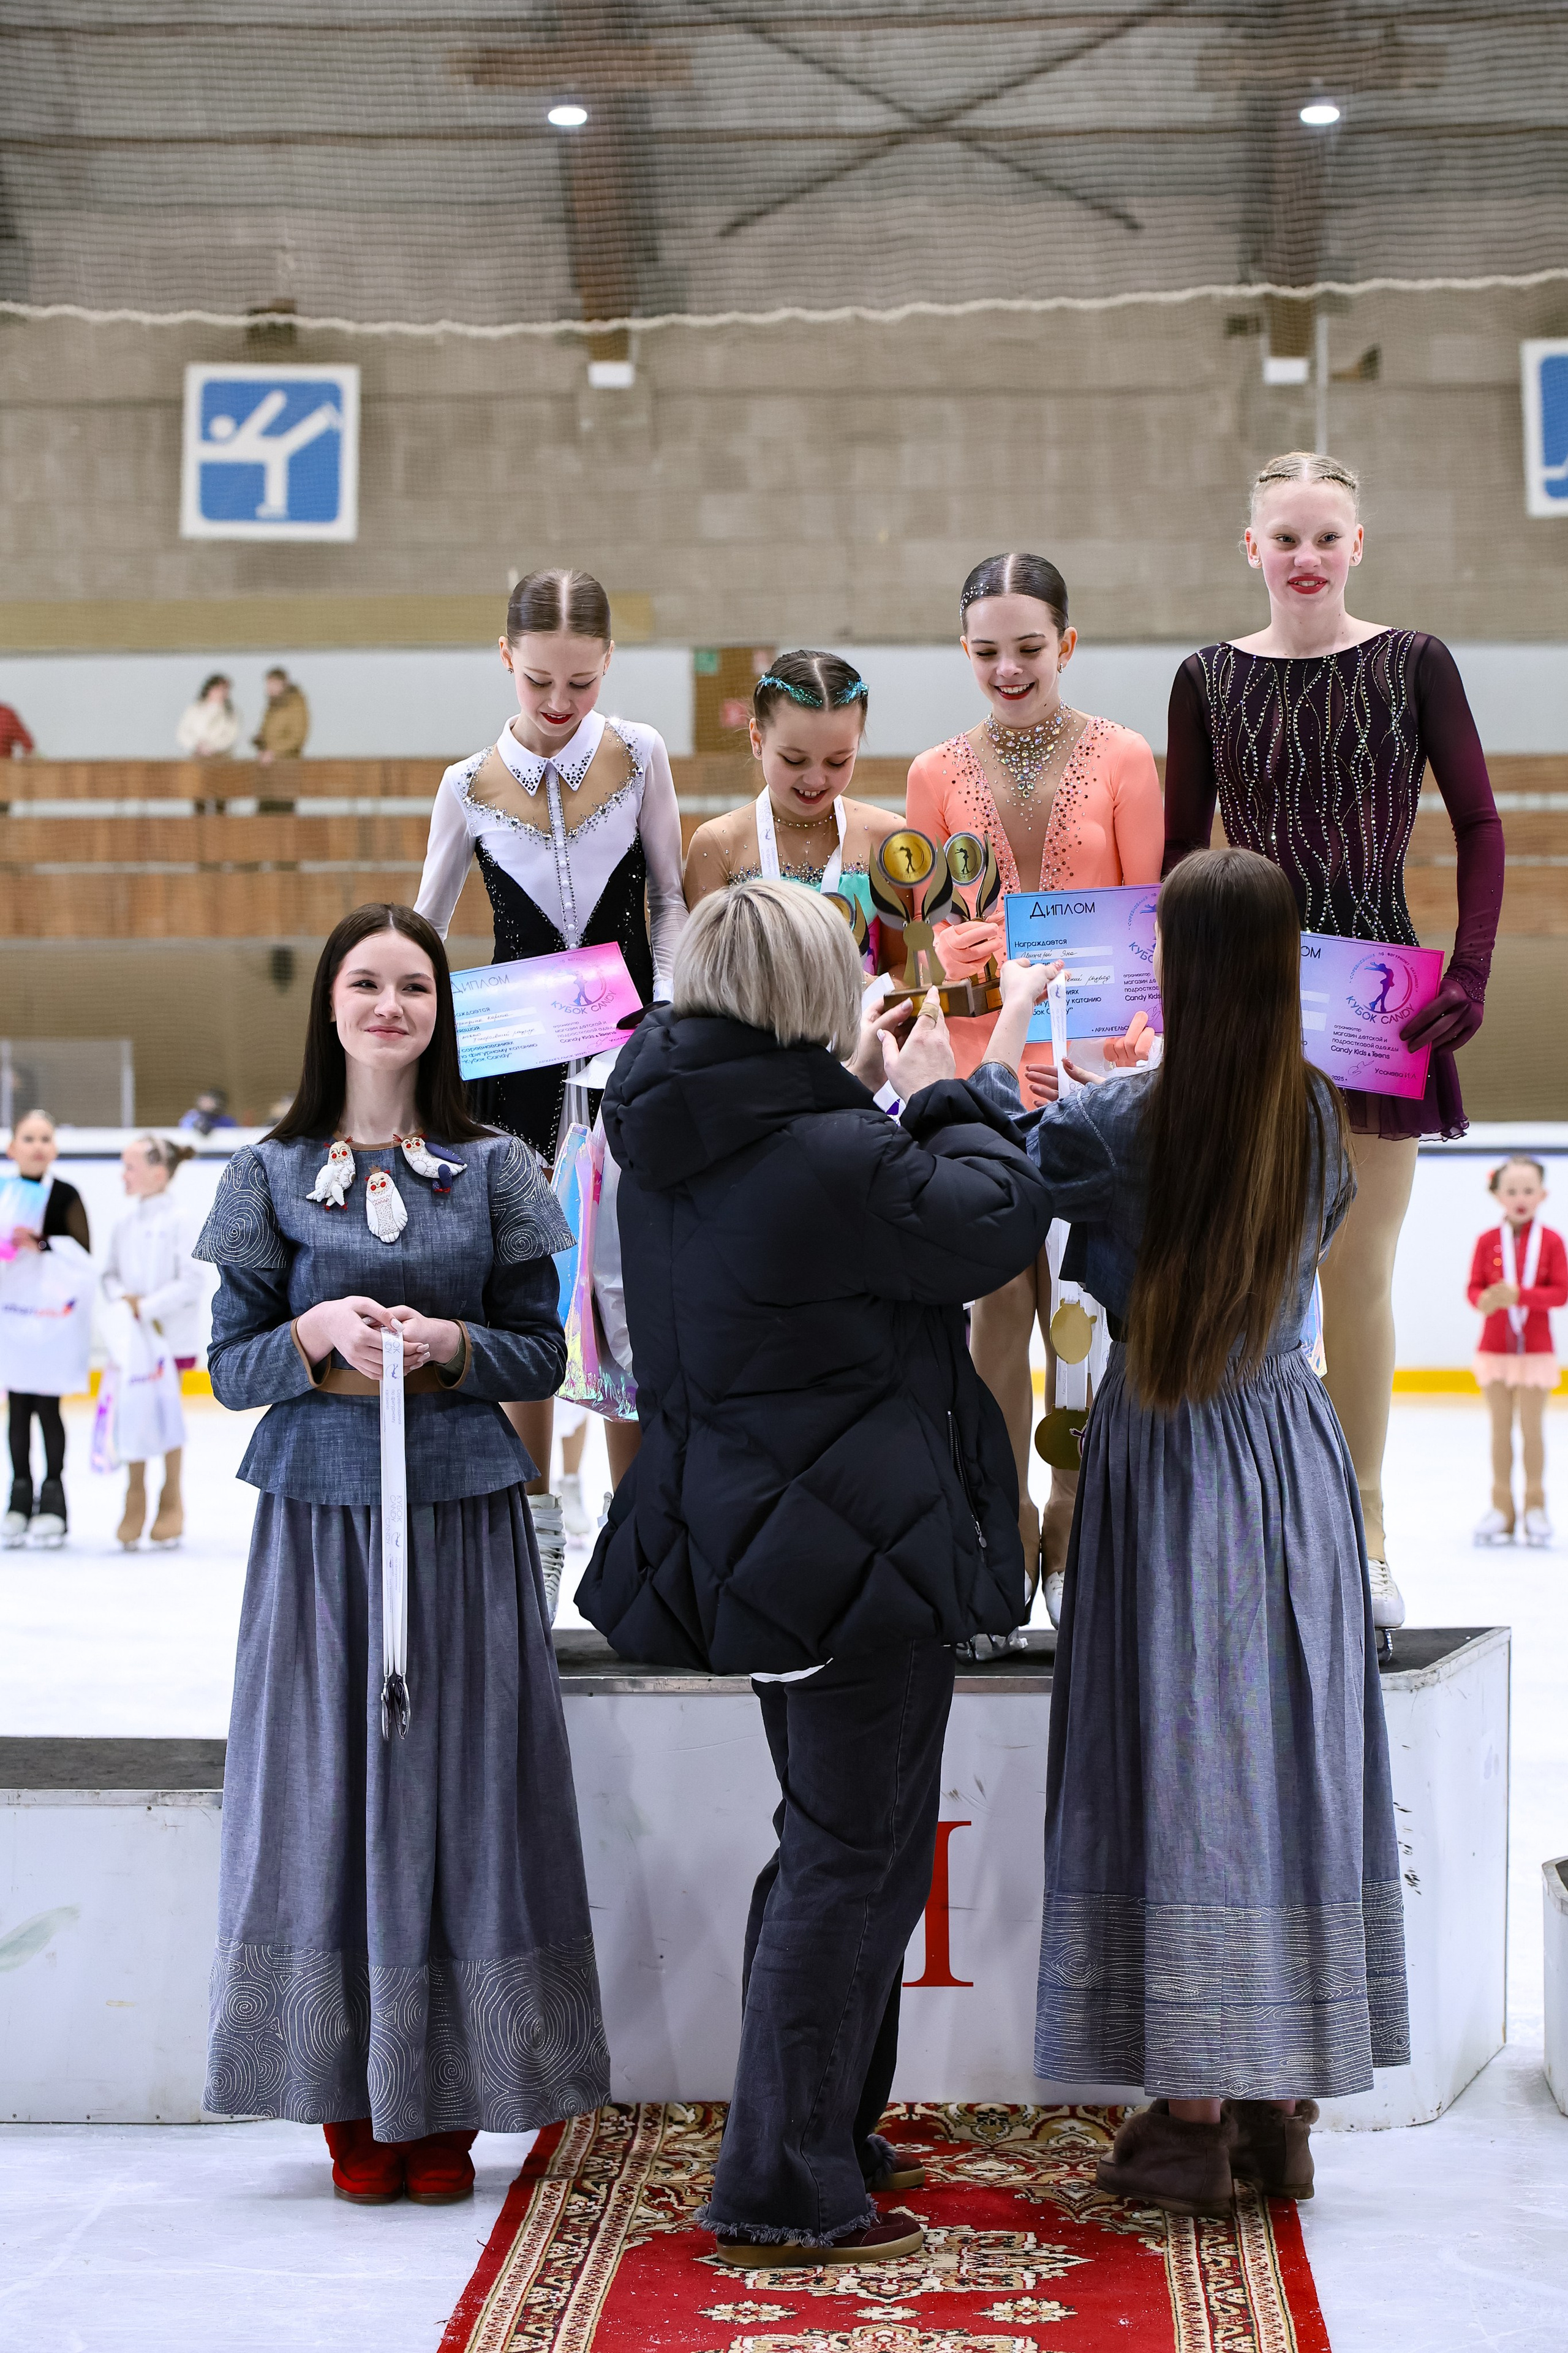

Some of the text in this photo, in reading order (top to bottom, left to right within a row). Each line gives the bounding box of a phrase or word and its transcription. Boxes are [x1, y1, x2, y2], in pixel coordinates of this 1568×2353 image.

[1014, 939, 1068, 949] Награждается
[1129, 942, 1153, 963] КУБО
[551, 990, 617, 1014] КУБОК CANDY
[1125, 994, 1147, 1002] Candy
[456, 1007, 491, 1017] аждается
[1346, 995, 1414, 1024] КУБОК CANDY
[579, 1021, 602, 1029] детской
[1358, 1034, 1383, 1043] детской
[461, 1041, 514, 1053] соревнованиях
[1332, 1038, 1399, 1052] подростковой одежды
[469, 1048, 508, 1058] фигурному
[1330, 1045, 1353, 1056] Candy
[1371, 1051, 1390, 1060] Teens
